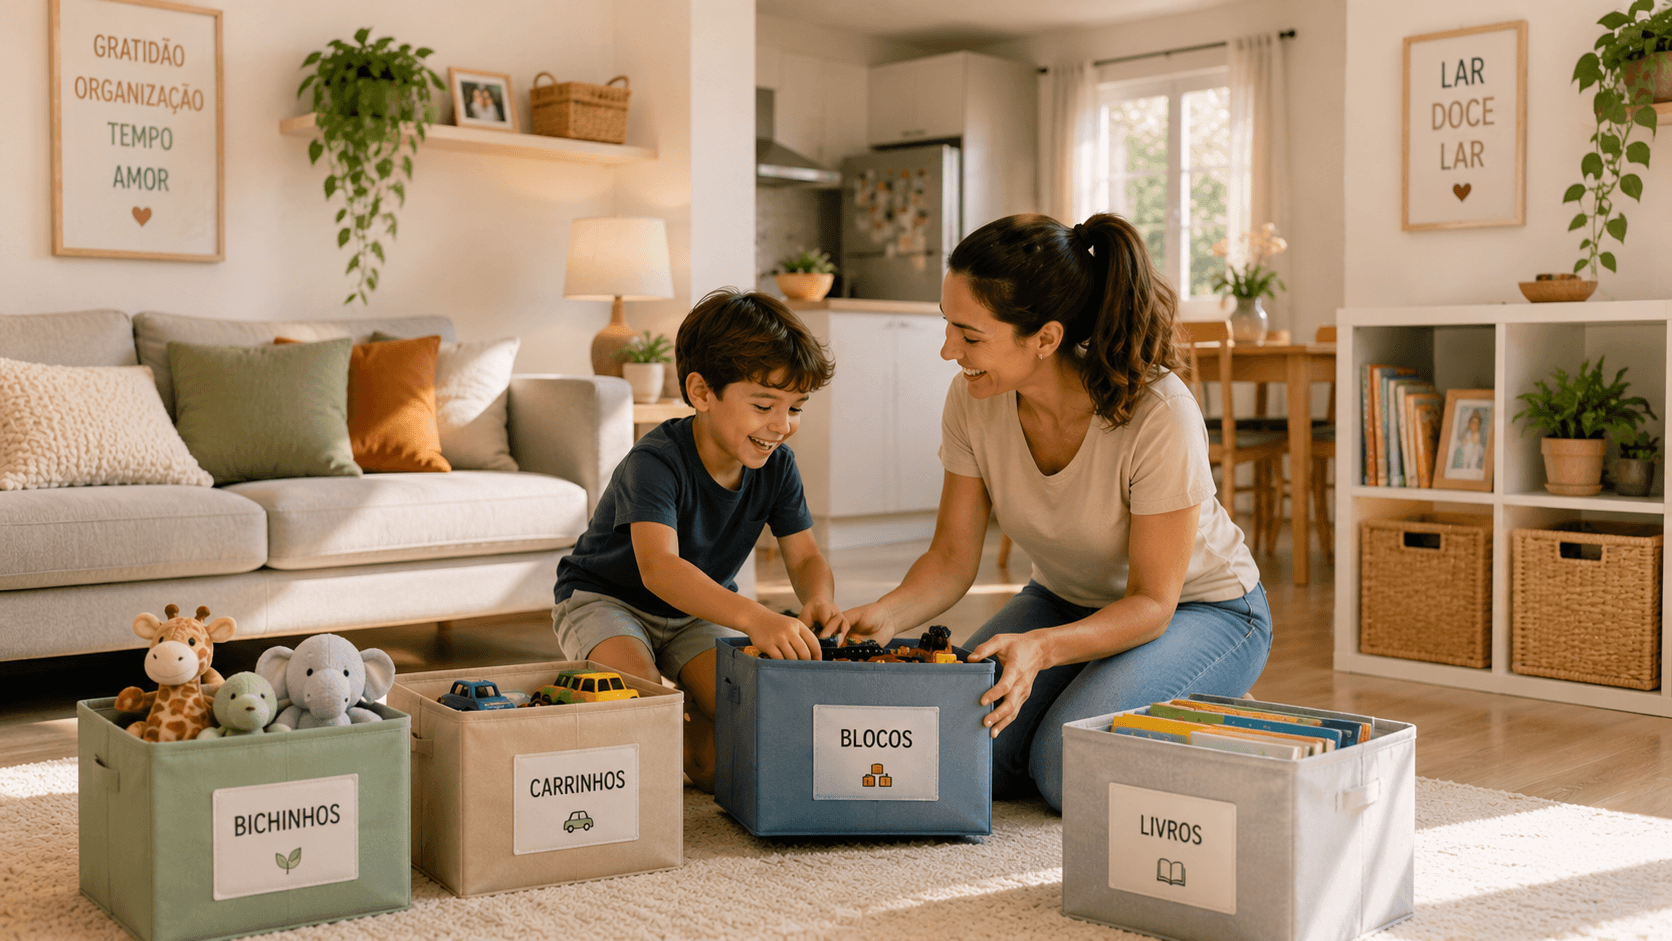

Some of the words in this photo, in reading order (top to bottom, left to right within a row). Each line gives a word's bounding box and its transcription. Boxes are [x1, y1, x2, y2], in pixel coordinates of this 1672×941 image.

[94, 34, 185, 67] GRATIDÃO
[1441, 57, 1484, 89] LAR
[75, 76, 204, 114] ORGANIZAÇÃO
[1432, 97, 1495, 131] DOCE
[107, 122, 173, 151] TEMPO
[1441, 140, 1484, 171] LAR
[113, 165, 169, 191] AMOR
[841, 729, 912, 748] BLOCOS
[530, 770, 625, 797] CARRINHOS
[235, 804, 340, 836] BICHINHOS
[1141, 814, 1202, 845] LIVROS
